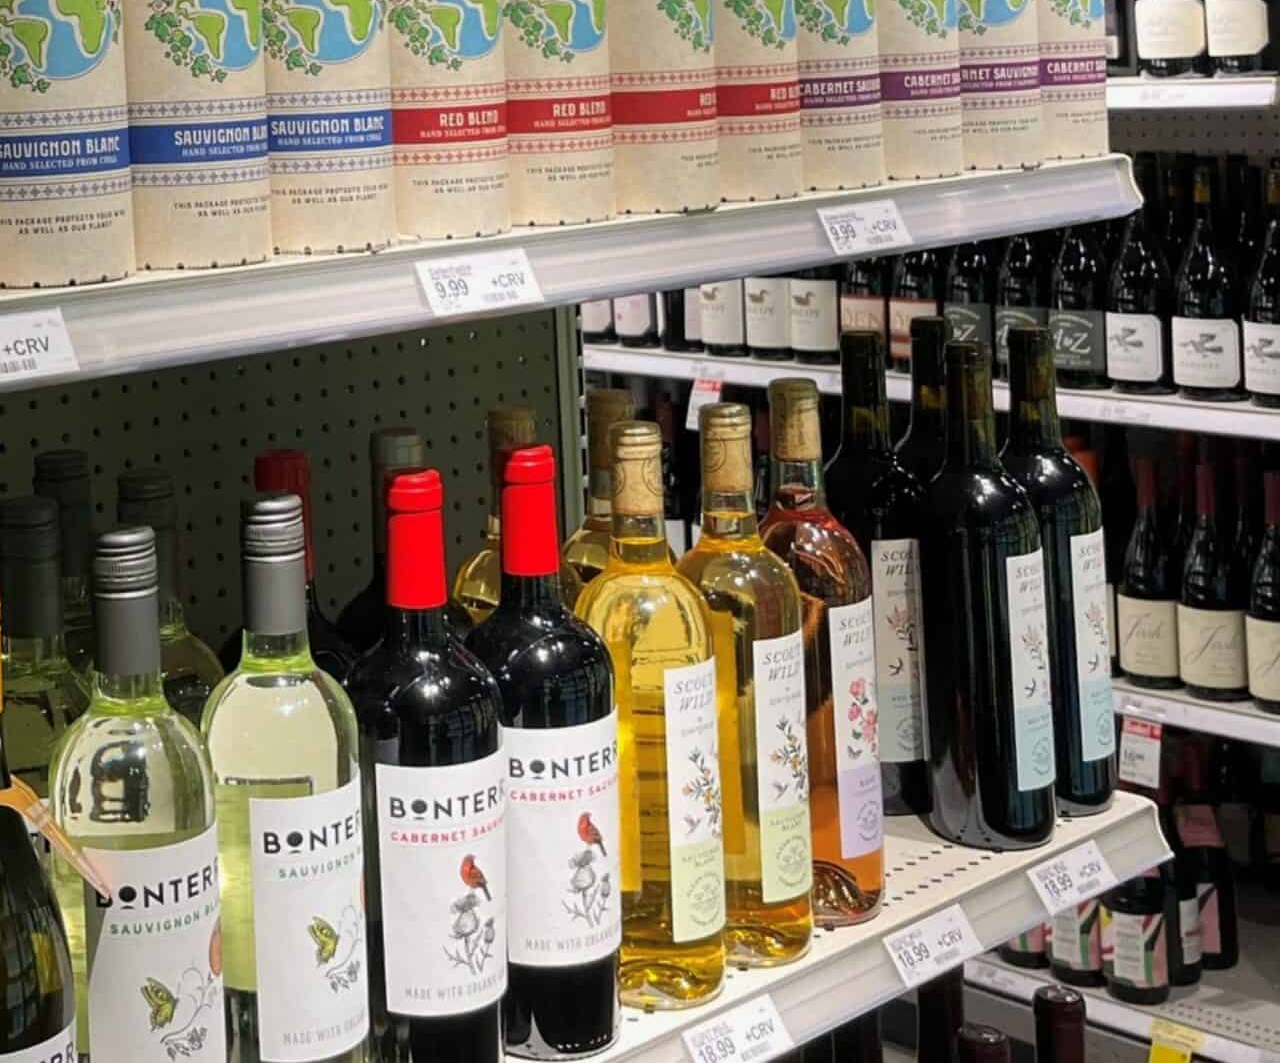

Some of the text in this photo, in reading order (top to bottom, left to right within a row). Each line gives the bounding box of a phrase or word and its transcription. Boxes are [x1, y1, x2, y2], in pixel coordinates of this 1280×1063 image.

[553, 100, 606, 117] RED BLEND
[271, 116, 350, 135] SAUVIGNON
[354, 115, 384, 132] BLANC
[439, 110, 499, 127] RED BLEND
[86, 135, 120, 154] BLANC
[174, 125, 250, 146] SAUVIGNON
[435, 278, 469, 299] 9.99
[3, 337, 50, 356] +CRV
[510, 789, 582, 802] CABERNET
[391, 830, 466, 844] CABERNET
[111, 913, 200, 935] SAUVIGNON
